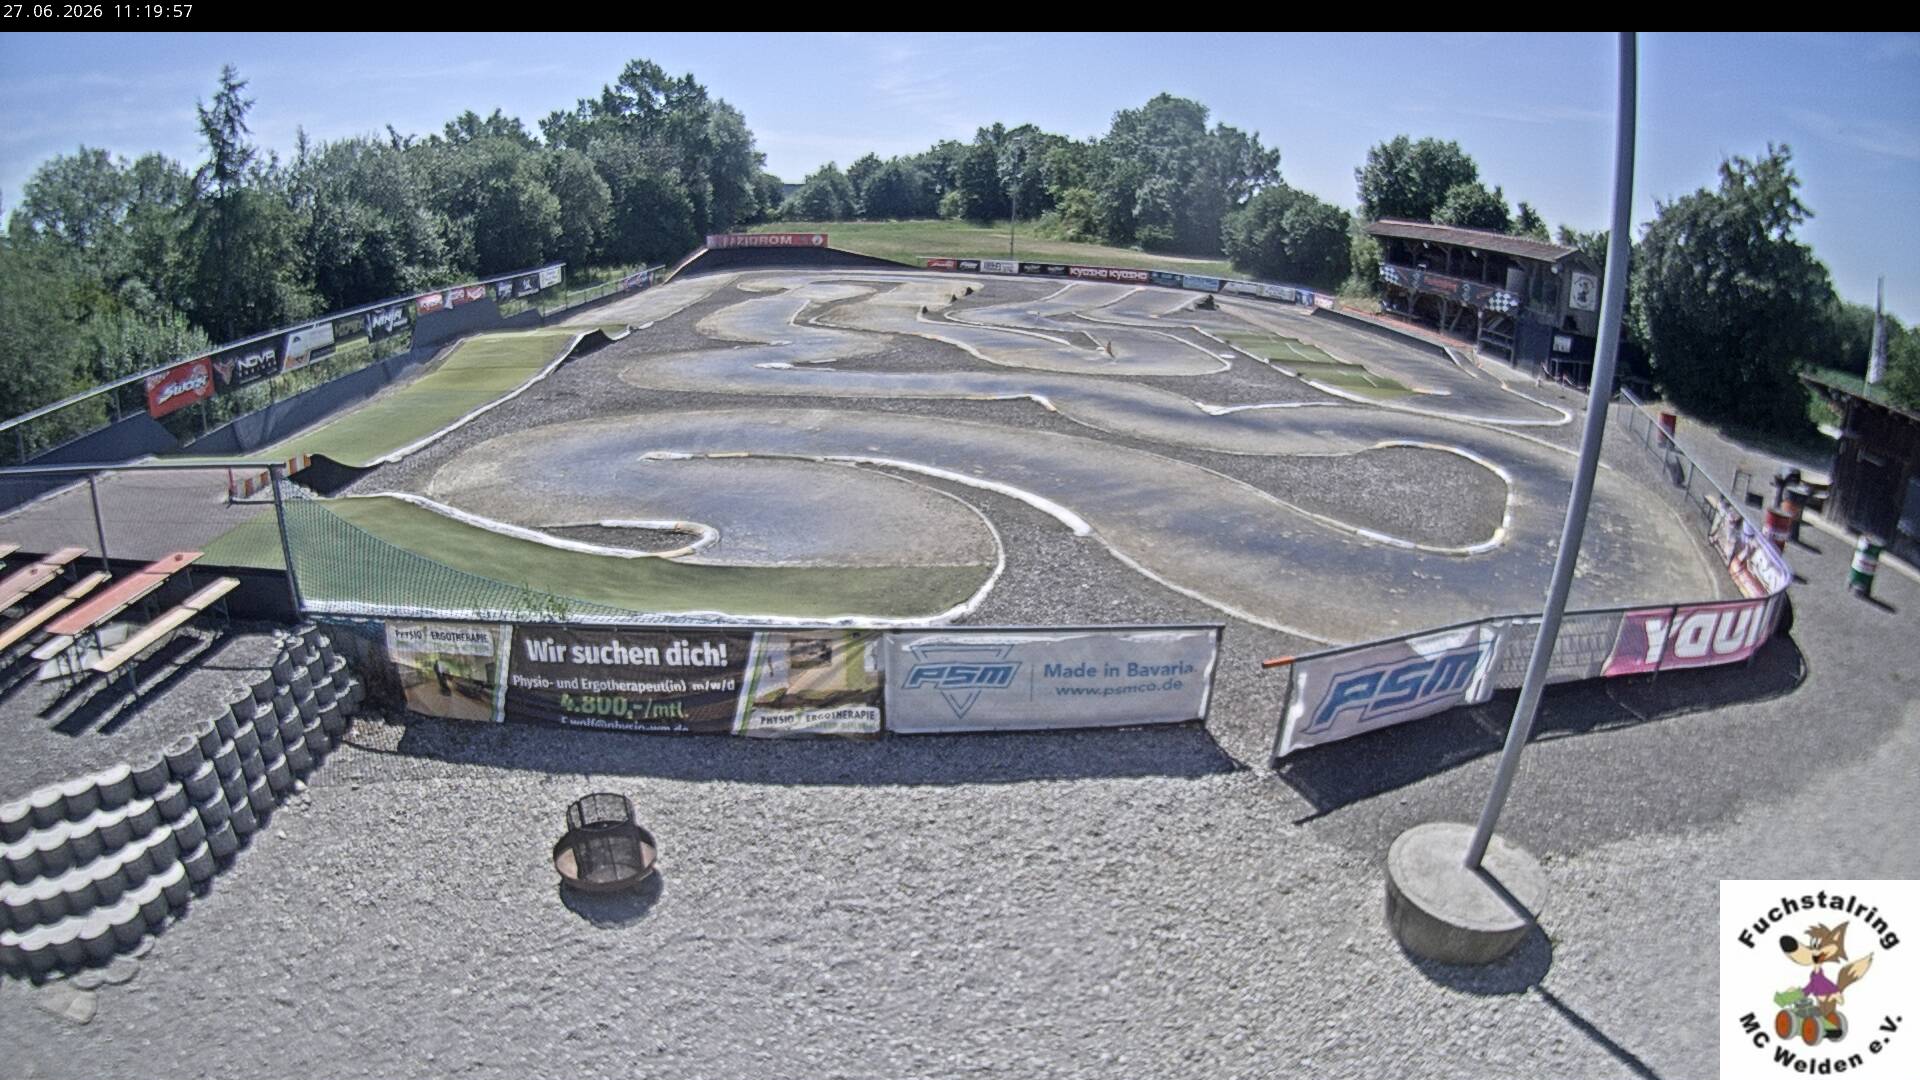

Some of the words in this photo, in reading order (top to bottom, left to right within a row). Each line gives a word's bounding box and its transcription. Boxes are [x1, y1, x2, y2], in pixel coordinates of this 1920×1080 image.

[238, 350, 276, 372] NOVA
[430, 631, 489, 643] ERGOTHERAPIE
[525, 637, 568, 663] Wir
[572, 638, 660, 666] suchen
[665, 639, 729, 667] dich!
[908, 664, 1014, 687] PSM
[1043, 661, 1097, 679] Made
[1103, 662, 1120, 677] in
[512, 674, 554, 690] Physio-
[556, 677, 579, 689] und
[581, 678, 686, 693] Ergotherapeut(in)
[1056, 679, 1184, 698] www.psmco.de
[1311, 648, 1485, 729] PSM
[760, 715, 795, 725] PHYSIO
[806, 710, 876, 723] ERGOTHERAPIE
